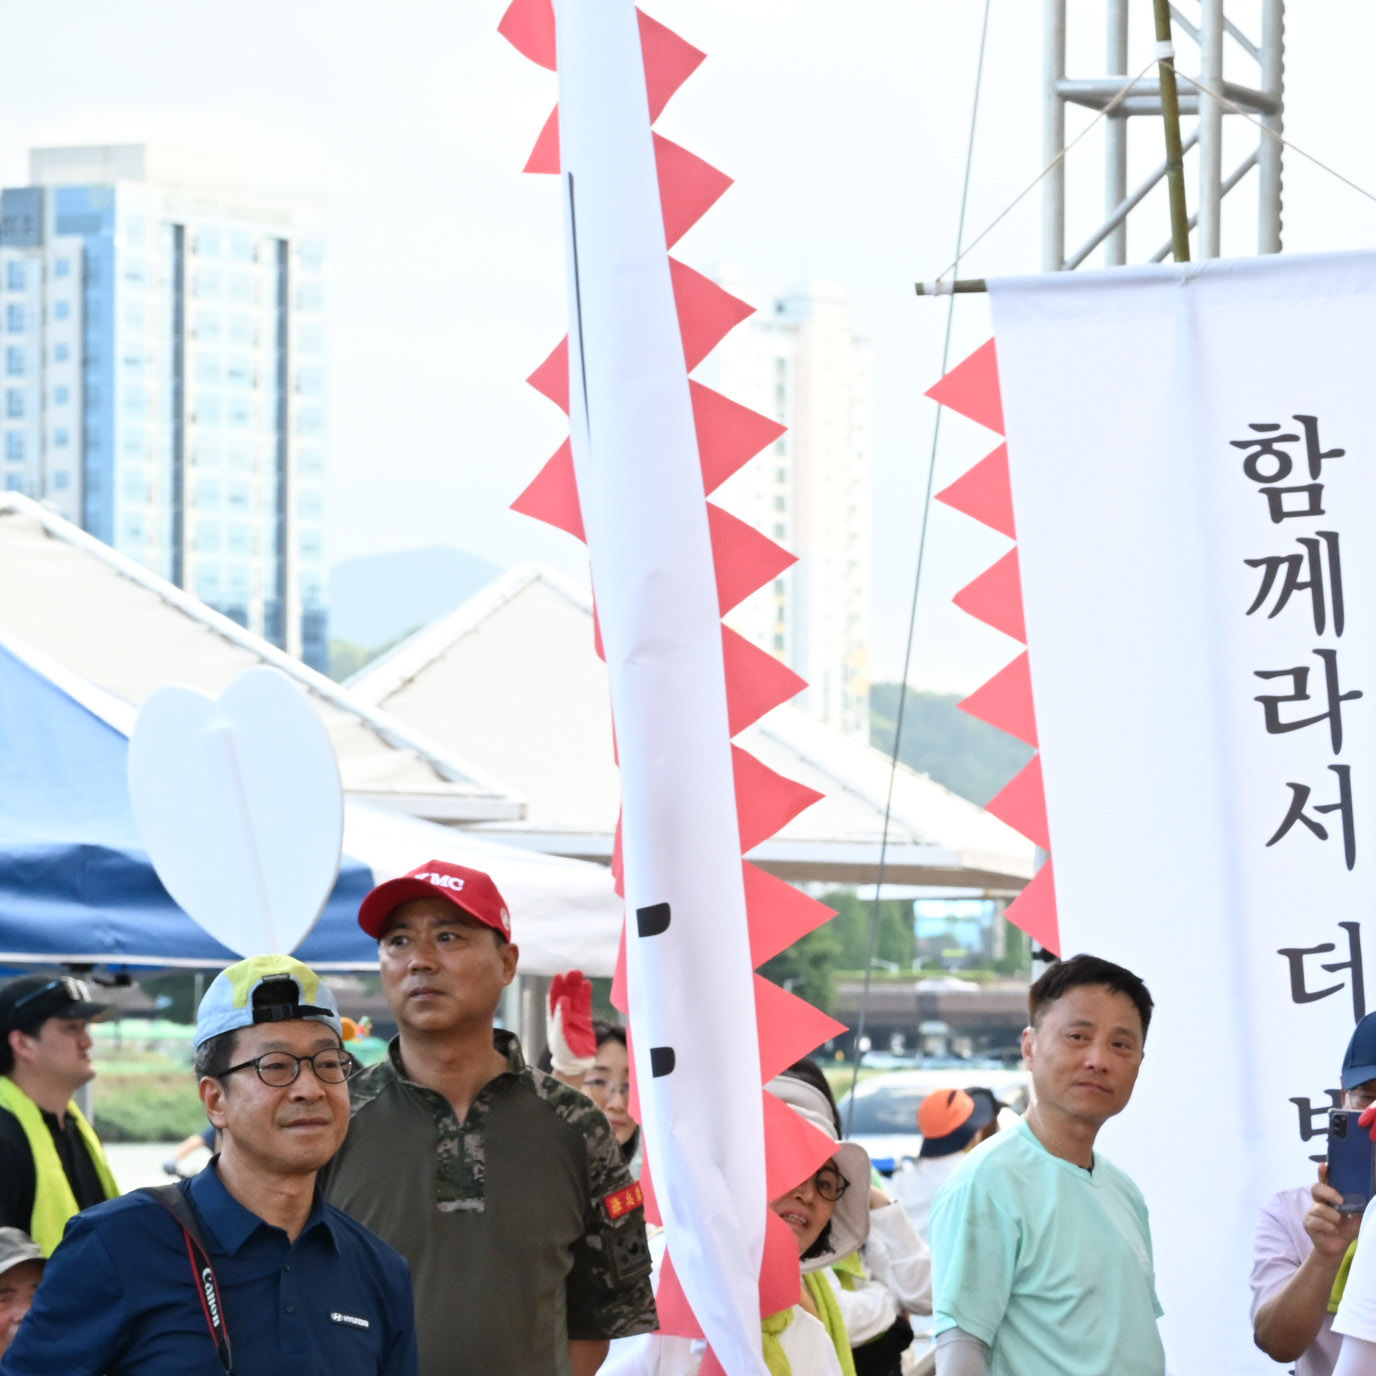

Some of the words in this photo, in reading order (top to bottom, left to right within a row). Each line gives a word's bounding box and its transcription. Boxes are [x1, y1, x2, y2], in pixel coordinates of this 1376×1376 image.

[1229, 415, 1364, 872] 함께라서
[1276, 921, 1366, 1025] 더
[202, 1267, 221, 1328] Canon
